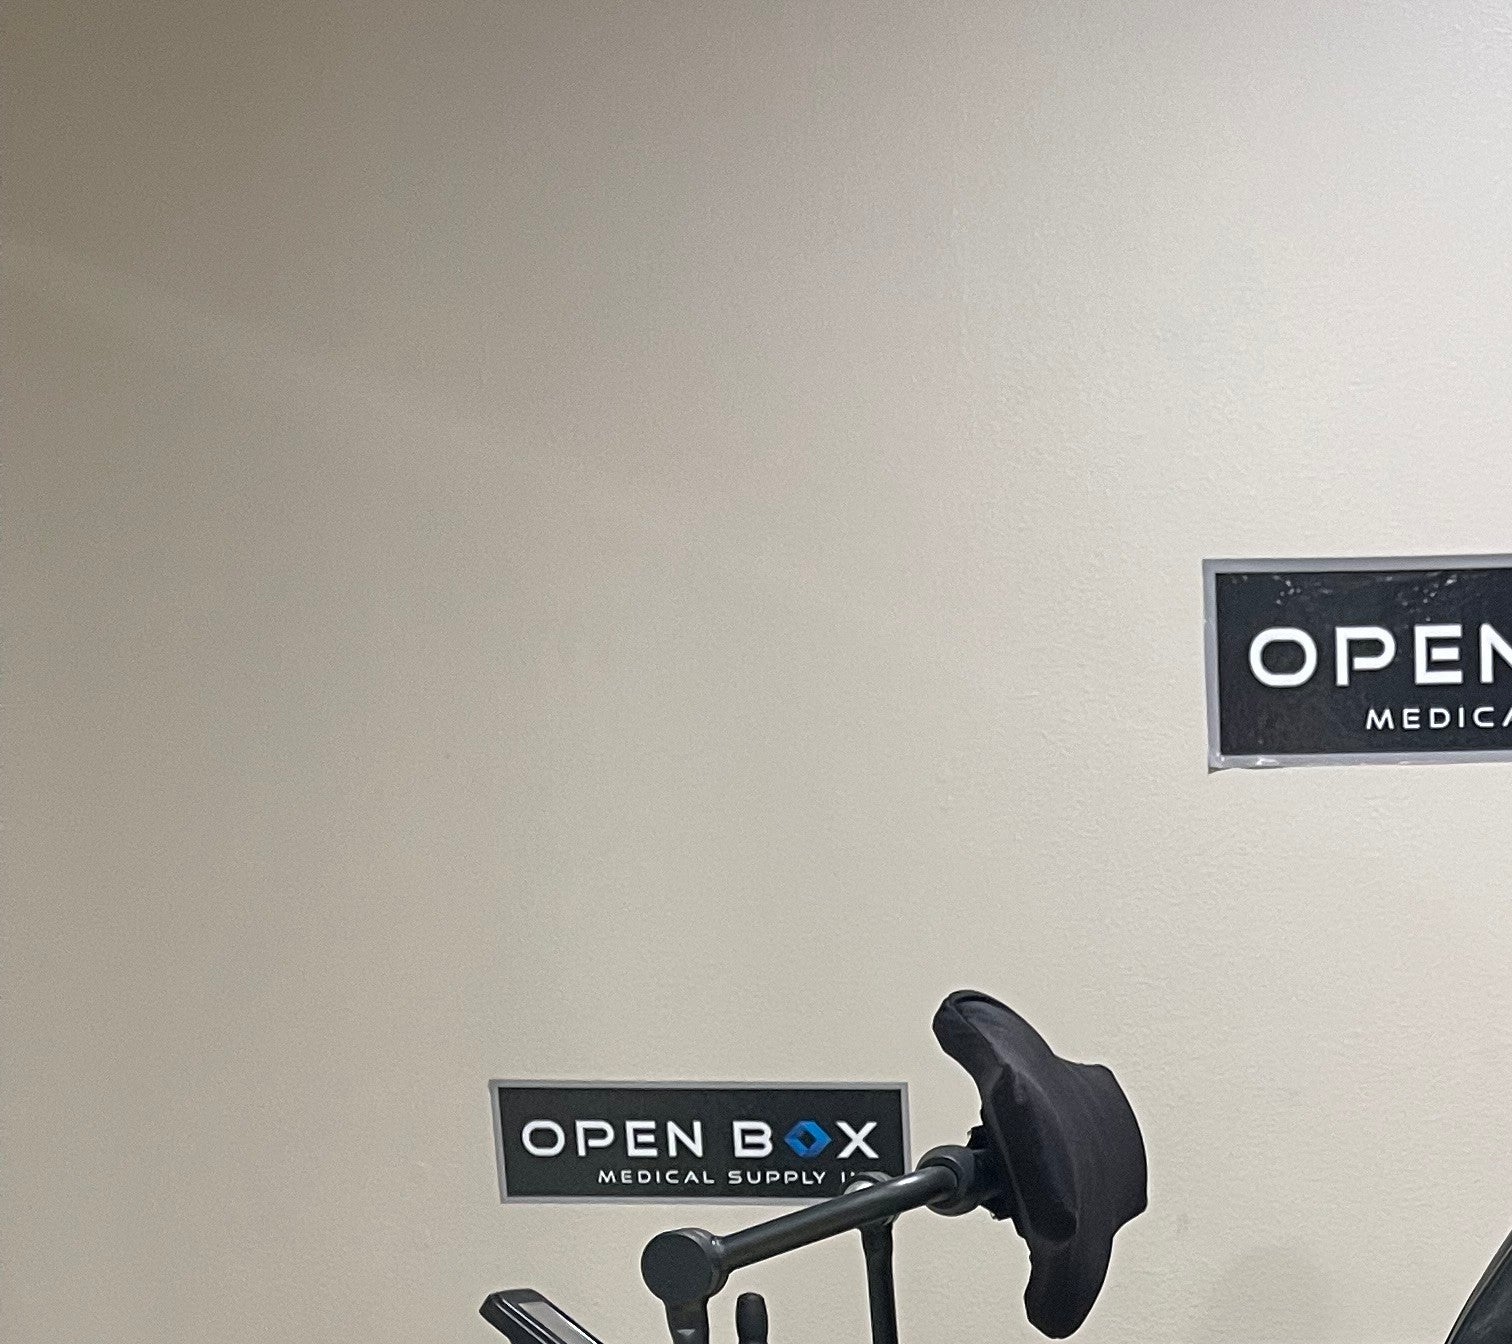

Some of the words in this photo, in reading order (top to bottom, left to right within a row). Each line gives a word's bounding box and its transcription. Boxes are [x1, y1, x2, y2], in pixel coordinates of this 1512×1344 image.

[521, 1119, 704, 1158] OPEN
[731, 1119, 880, 1159] BOX
[597, 1169, 716, 1185] MEDICAL
[727, 1169, 827, 1185] SUPPLY
